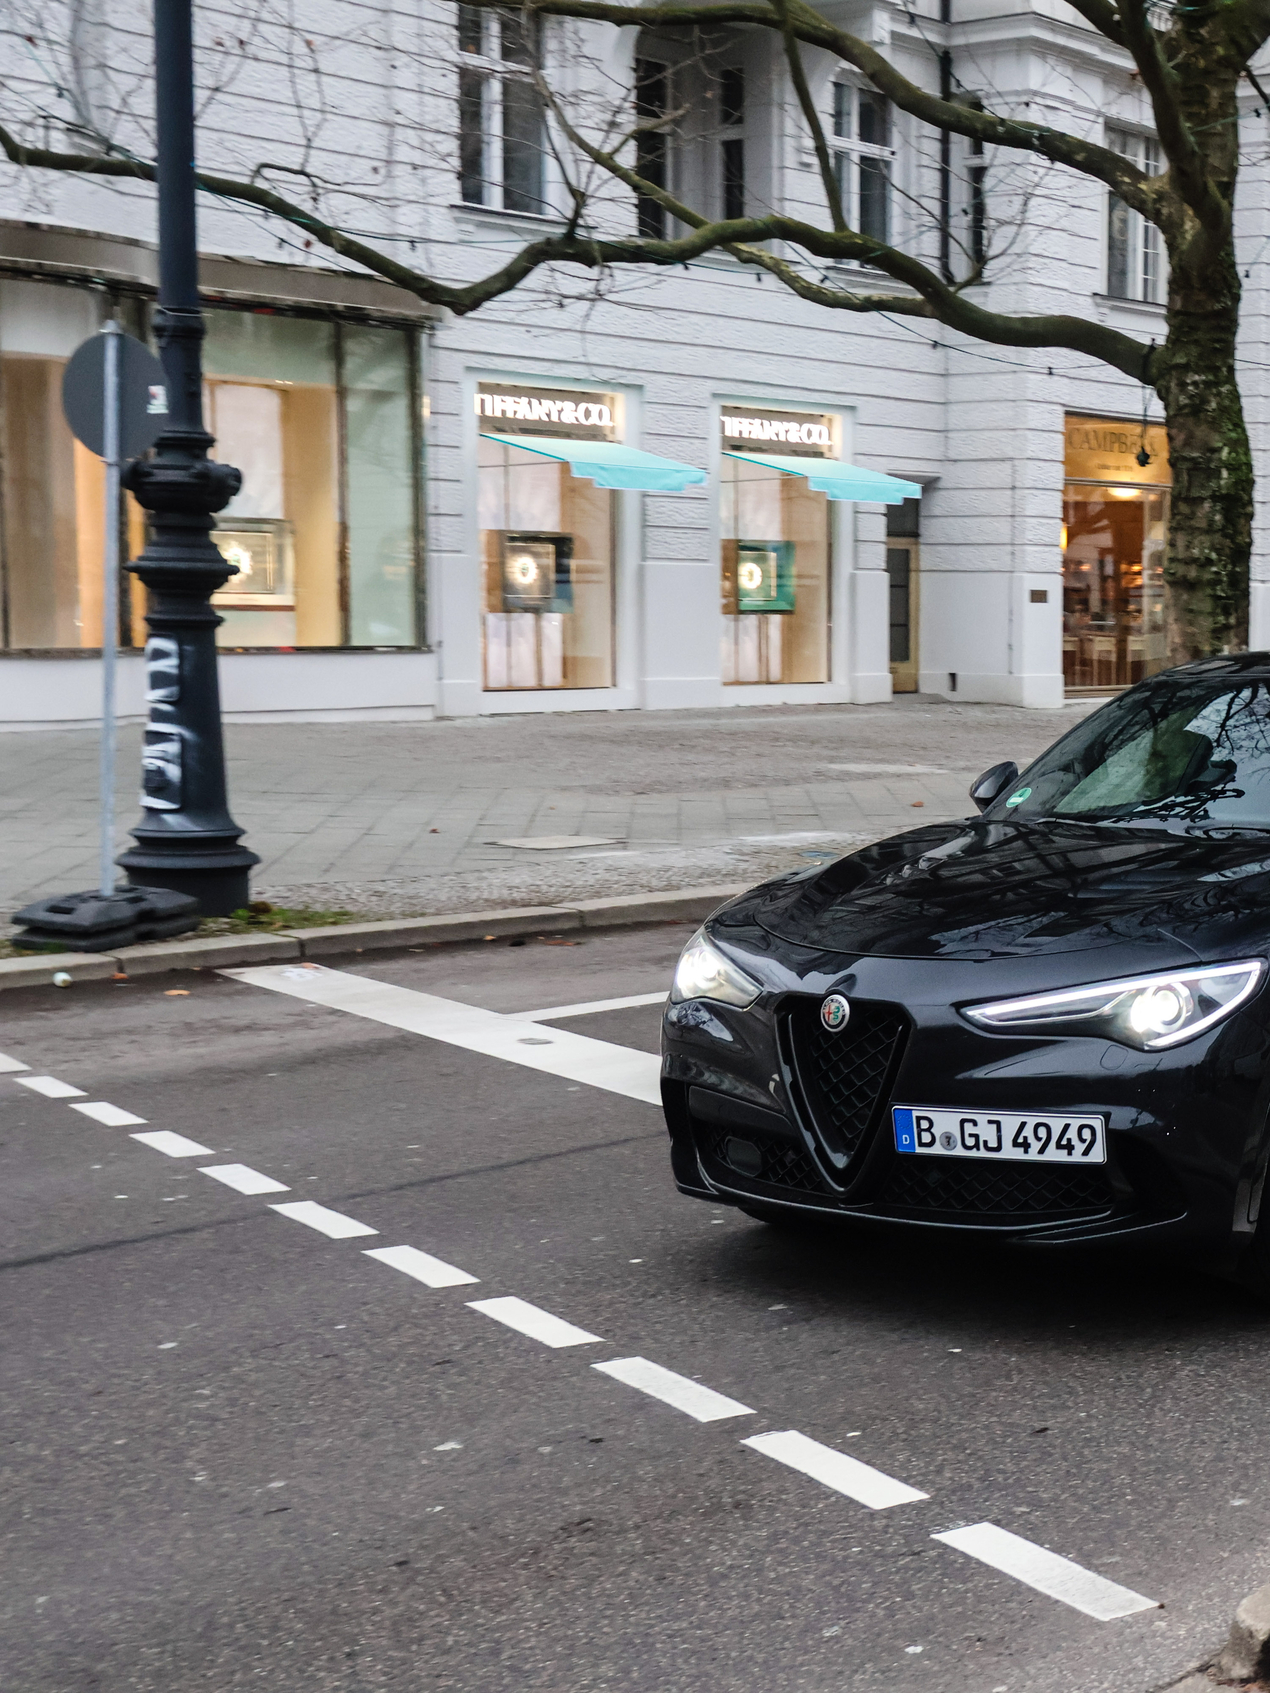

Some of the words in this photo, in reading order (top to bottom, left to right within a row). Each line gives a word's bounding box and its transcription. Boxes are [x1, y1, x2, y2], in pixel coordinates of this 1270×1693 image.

[915, 1115, 937, 1148] B
[959, 1117, 1003, 1153] GJ
[1011, 1120, 1098, 1157] 4949
